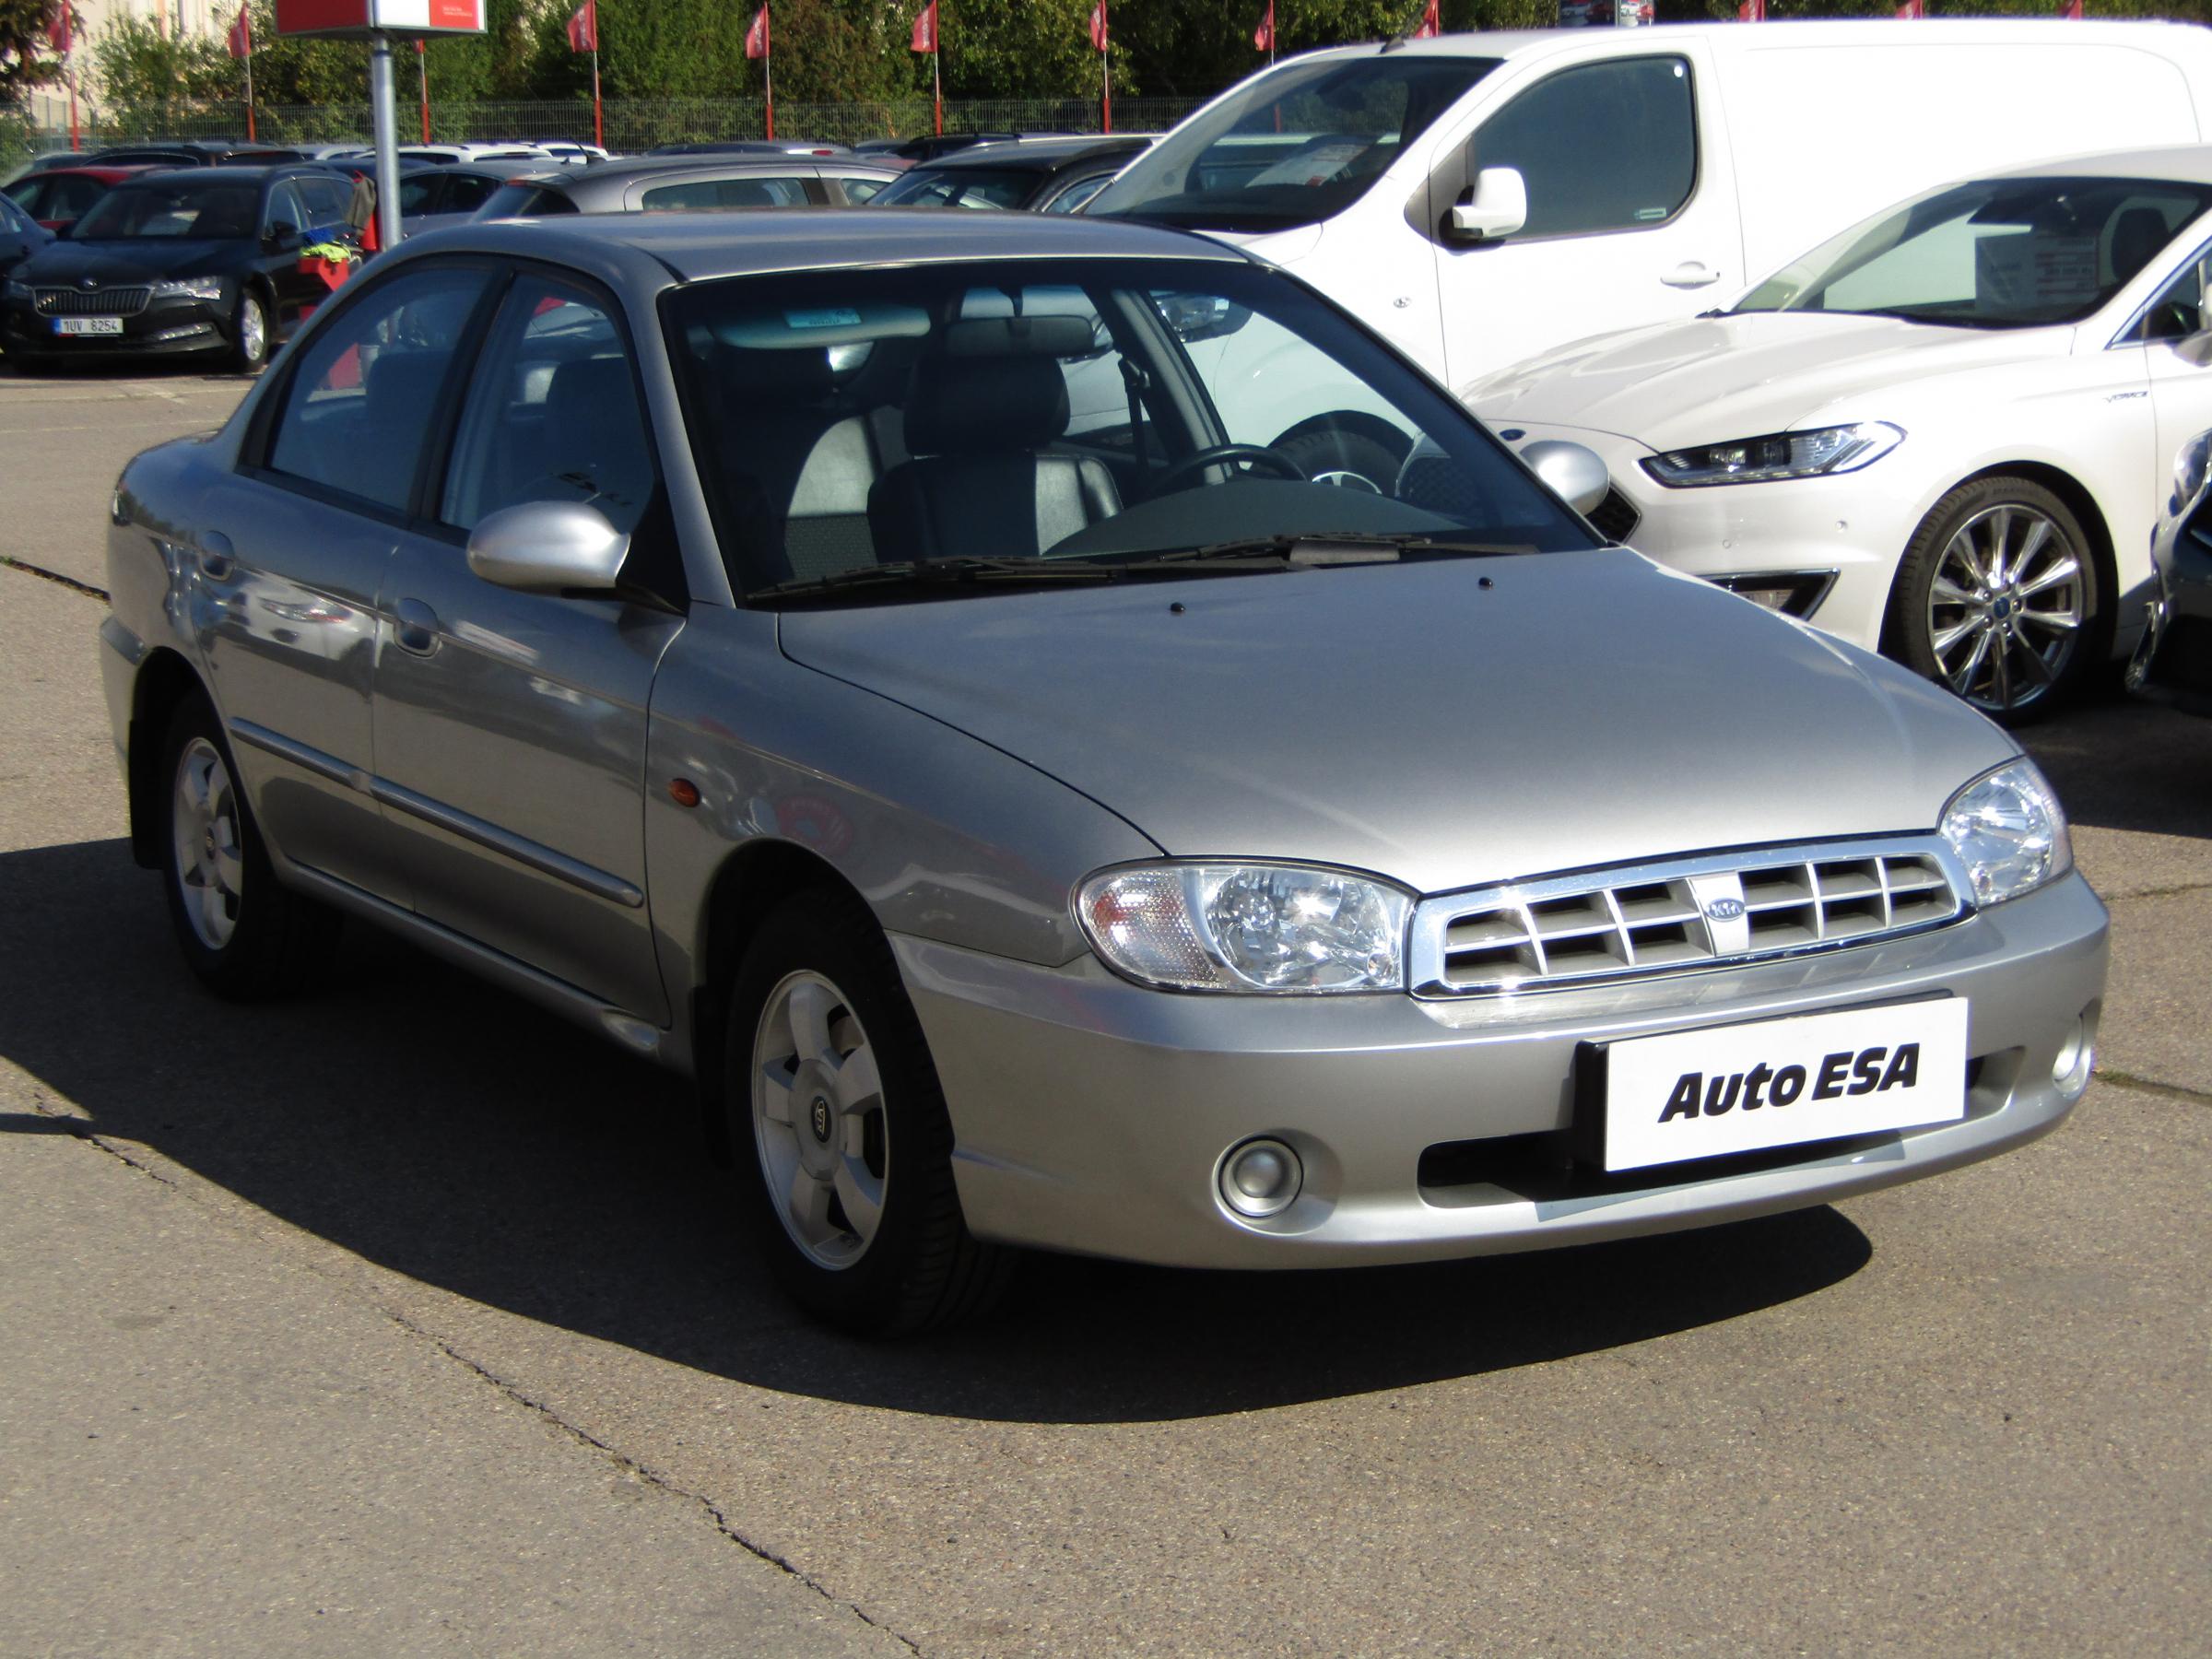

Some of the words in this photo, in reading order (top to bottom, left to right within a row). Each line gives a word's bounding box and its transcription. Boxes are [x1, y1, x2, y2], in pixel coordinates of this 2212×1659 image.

[64, 320, 83, 332] 1UV
[90, 320, 119, 332] 8254
[1711, 902, 1741, 916] KIA
[1657, 1062, 1806, 1123] Auto
[1811, 1042, 1920, 1100] ESA
